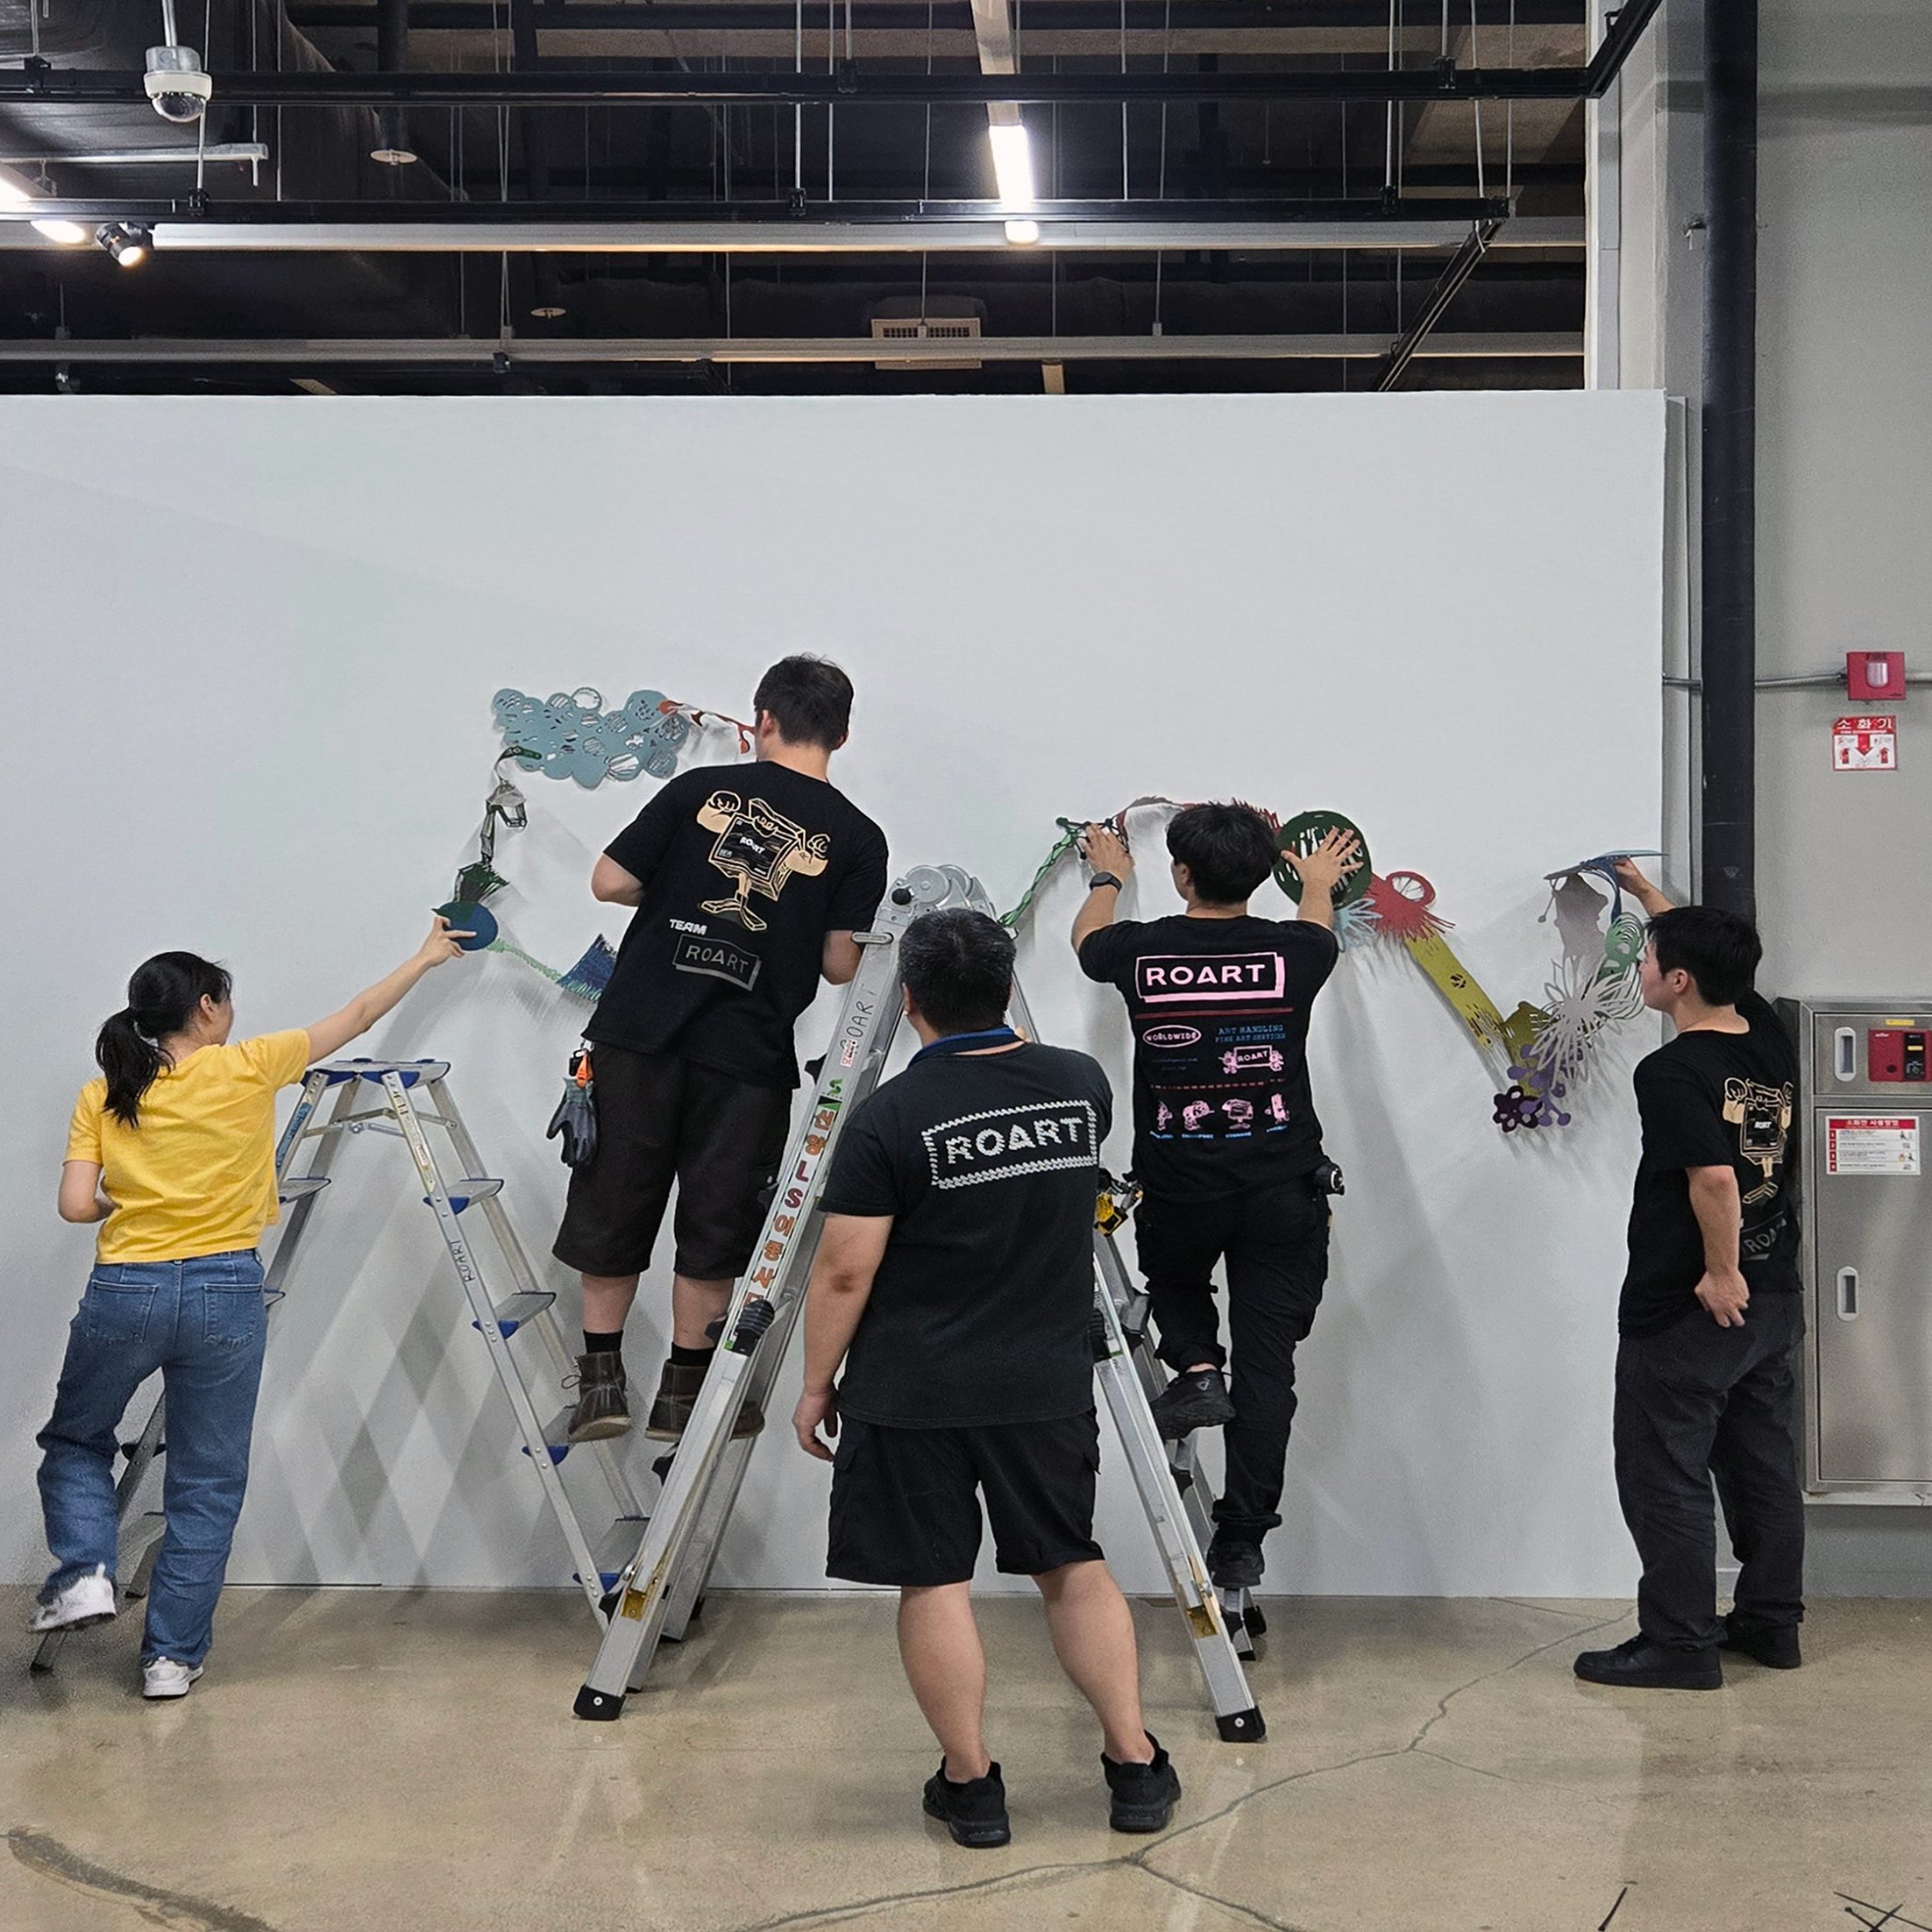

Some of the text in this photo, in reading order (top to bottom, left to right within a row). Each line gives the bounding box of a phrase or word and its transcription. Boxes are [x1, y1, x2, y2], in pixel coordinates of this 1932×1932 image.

[1836, 717, 1893, 729] 소화기
[668, 918, 707, 935] TEAM
[685, 944, 749, 975] ROART
[1146, 964, 1265, 986] ROART
[1146, 1032, 1197, 1041] WORLDWIDE
[1218, 1024, 1283, 1035] ART HANDLING
[1237, 1051, 1268, 1062] ROART
[945, 1118, 1083, 1164] ROART
